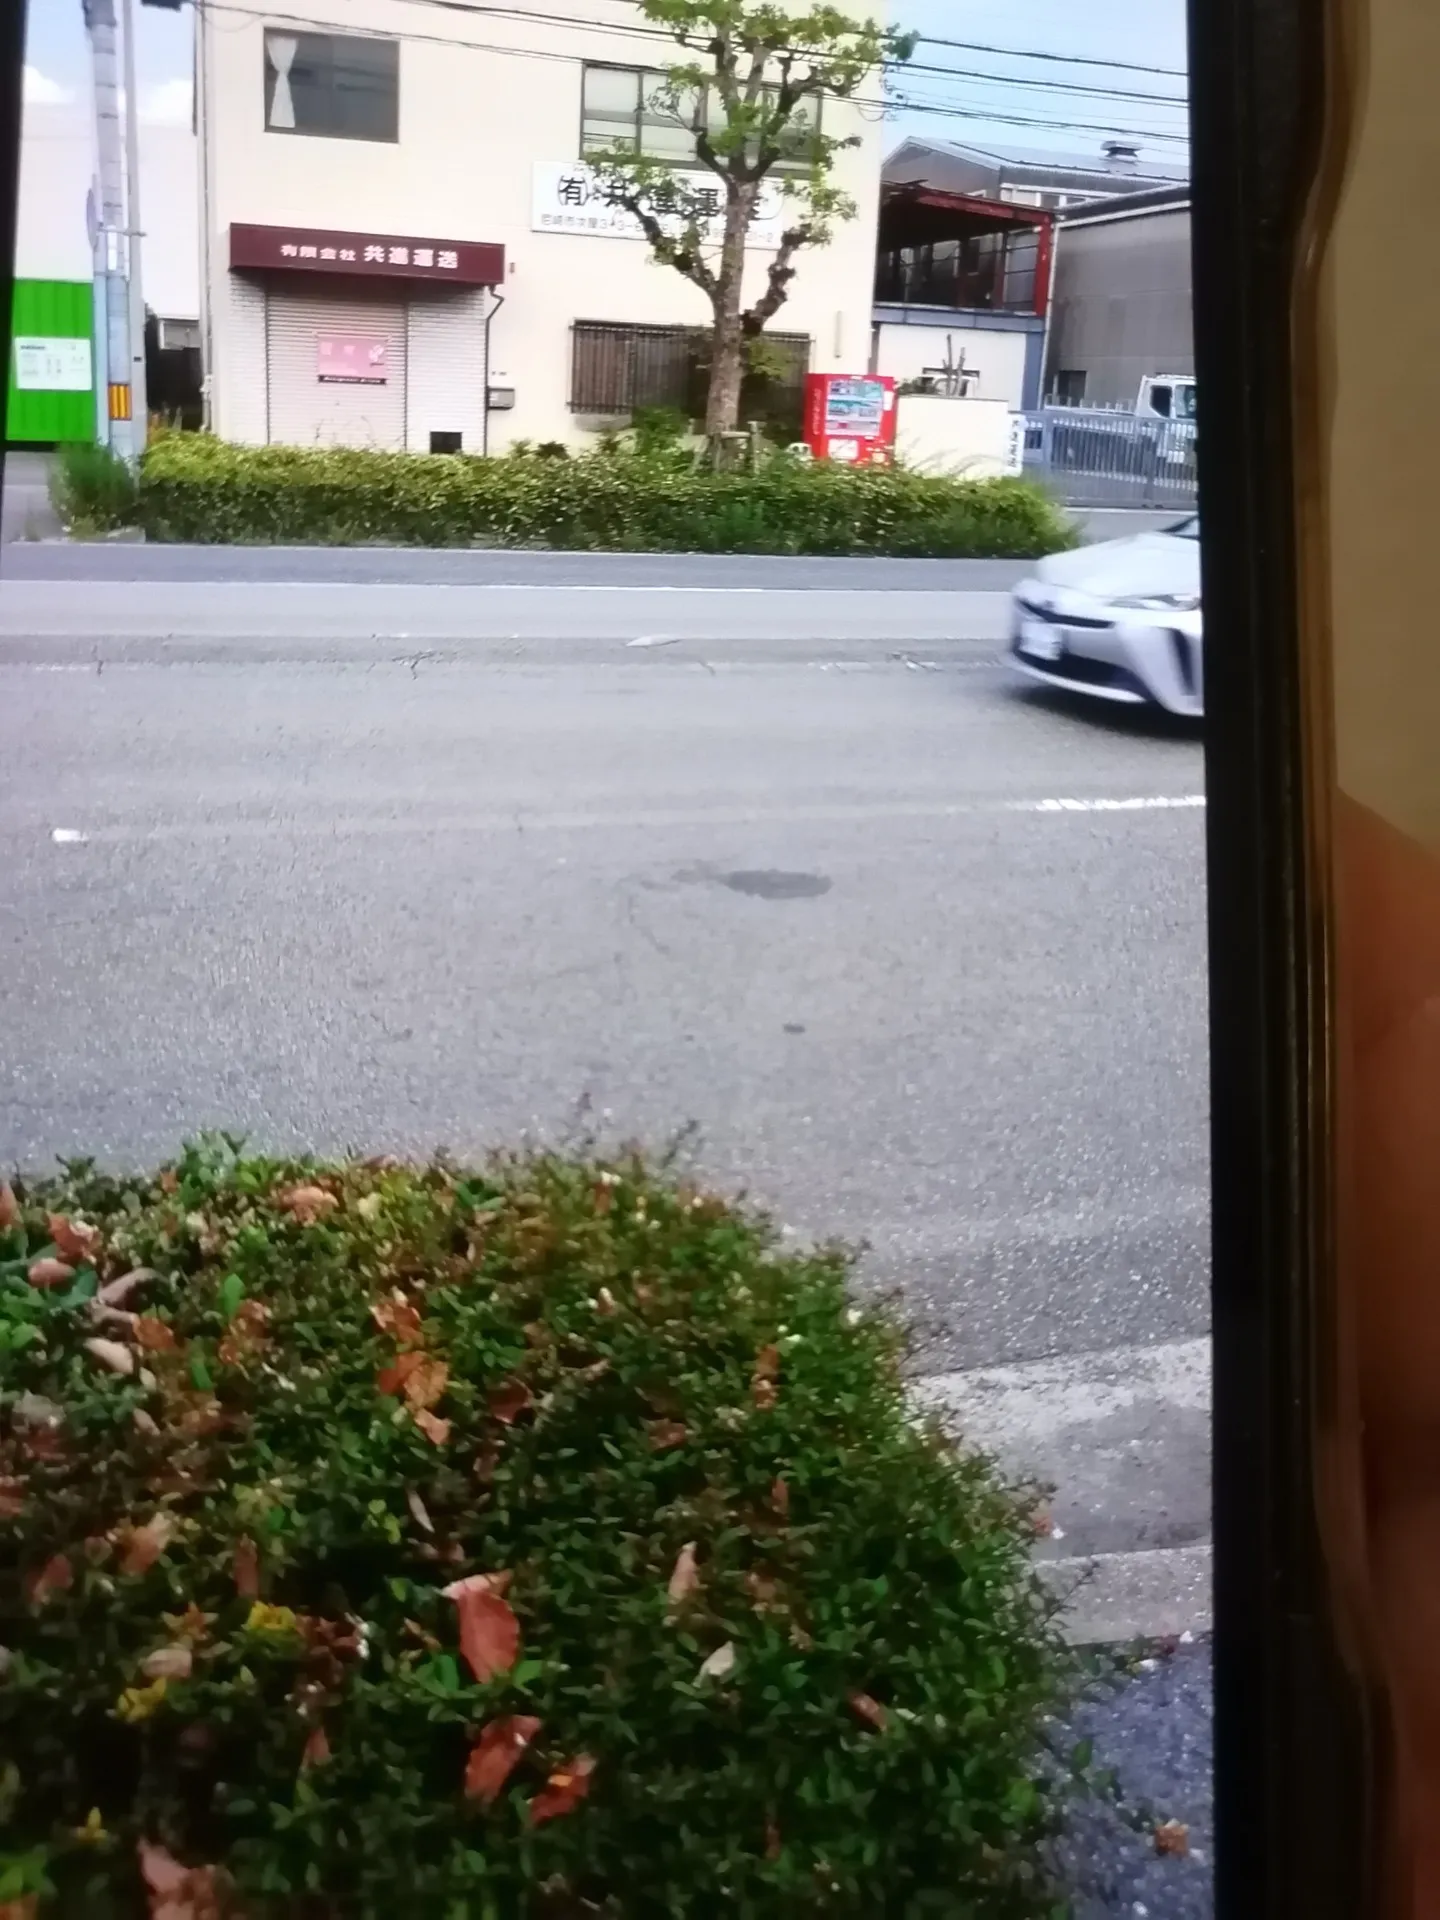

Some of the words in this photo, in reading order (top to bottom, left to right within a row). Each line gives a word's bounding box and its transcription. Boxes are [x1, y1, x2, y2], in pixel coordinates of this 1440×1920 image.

[280, 244, 357, 262] 有限会社
[363, 244, 459, 270] 共進運送
